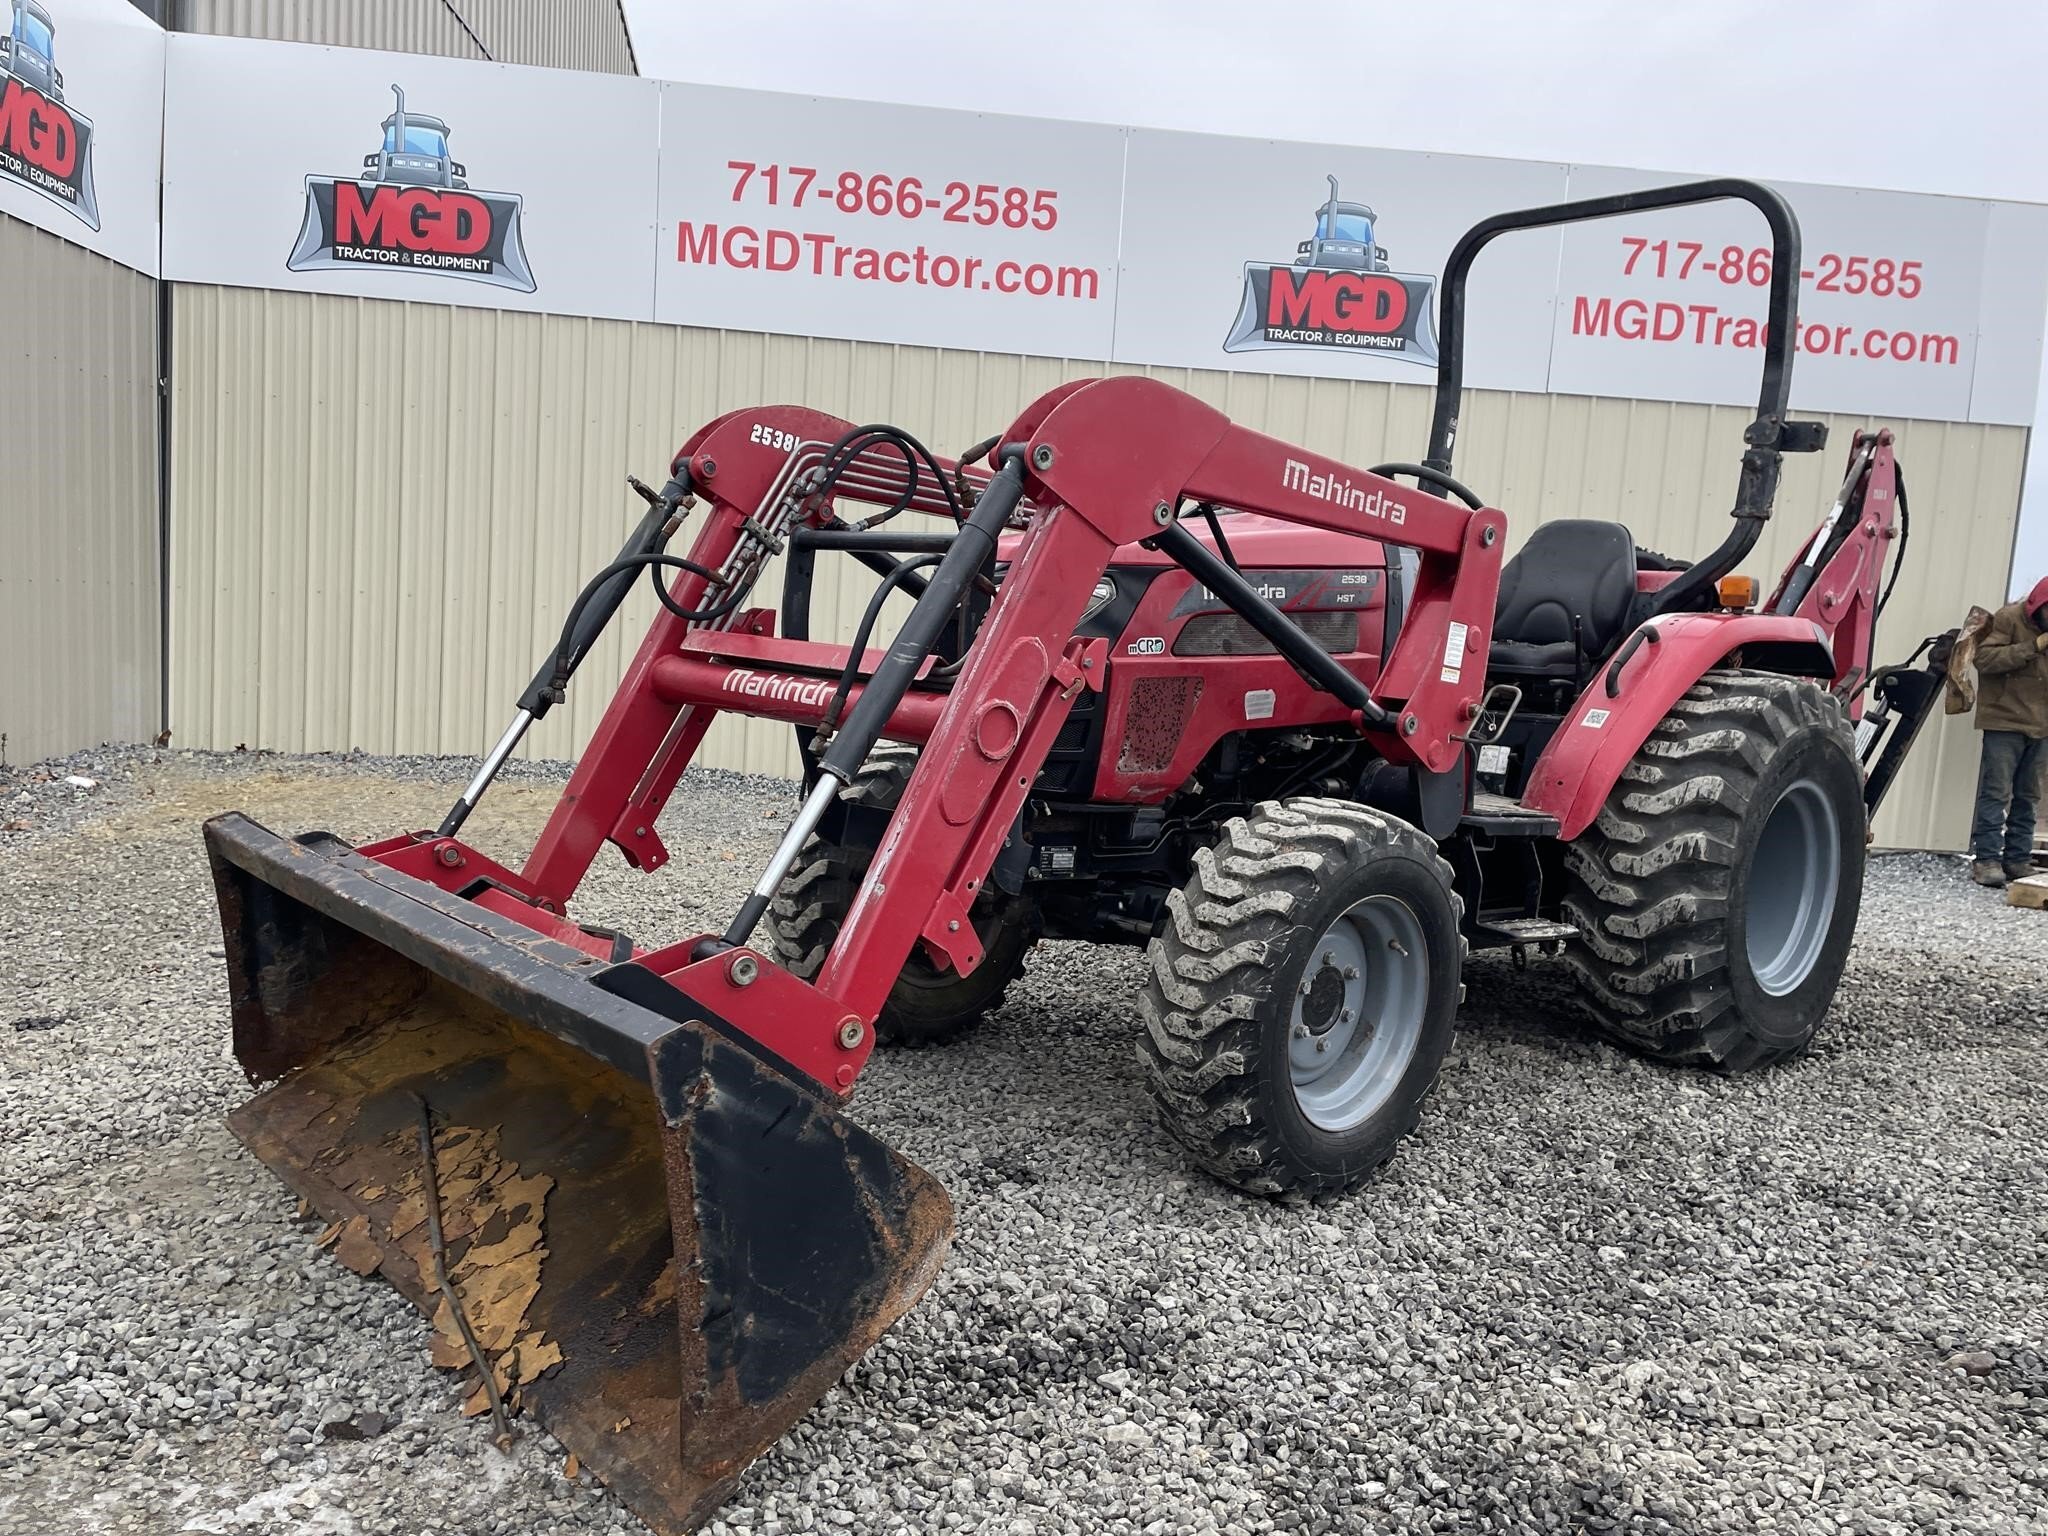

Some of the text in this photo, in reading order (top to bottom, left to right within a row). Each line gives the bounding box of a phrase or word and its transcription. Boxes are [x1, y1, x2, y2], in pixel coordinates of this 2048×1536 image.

[23, 164, 30, 177] &
[30, 167, 75, 199] EQUIPMENT
[727, 160, 1059, 231] 717-866-2585
[336, 183, 491, 254] MGD
[335, 245, 490, 271] TRACTOR & EQUIPMENT
[677, 221, 1099, 299] MGDTractor.com
[1621, 237, 1924, 299] 717-86-2585
[1268, 269, 1407, 334] MGD
[1267, 328, 1404, 348] TRACTOR & EQUIPMENT
[1282, 458, 1407, 526] Mahindra
[1337, 594, 1355, 603] HST
[1341, 575, 1367, 584] 2538
[722, 668, 839, 706] Mahindr
